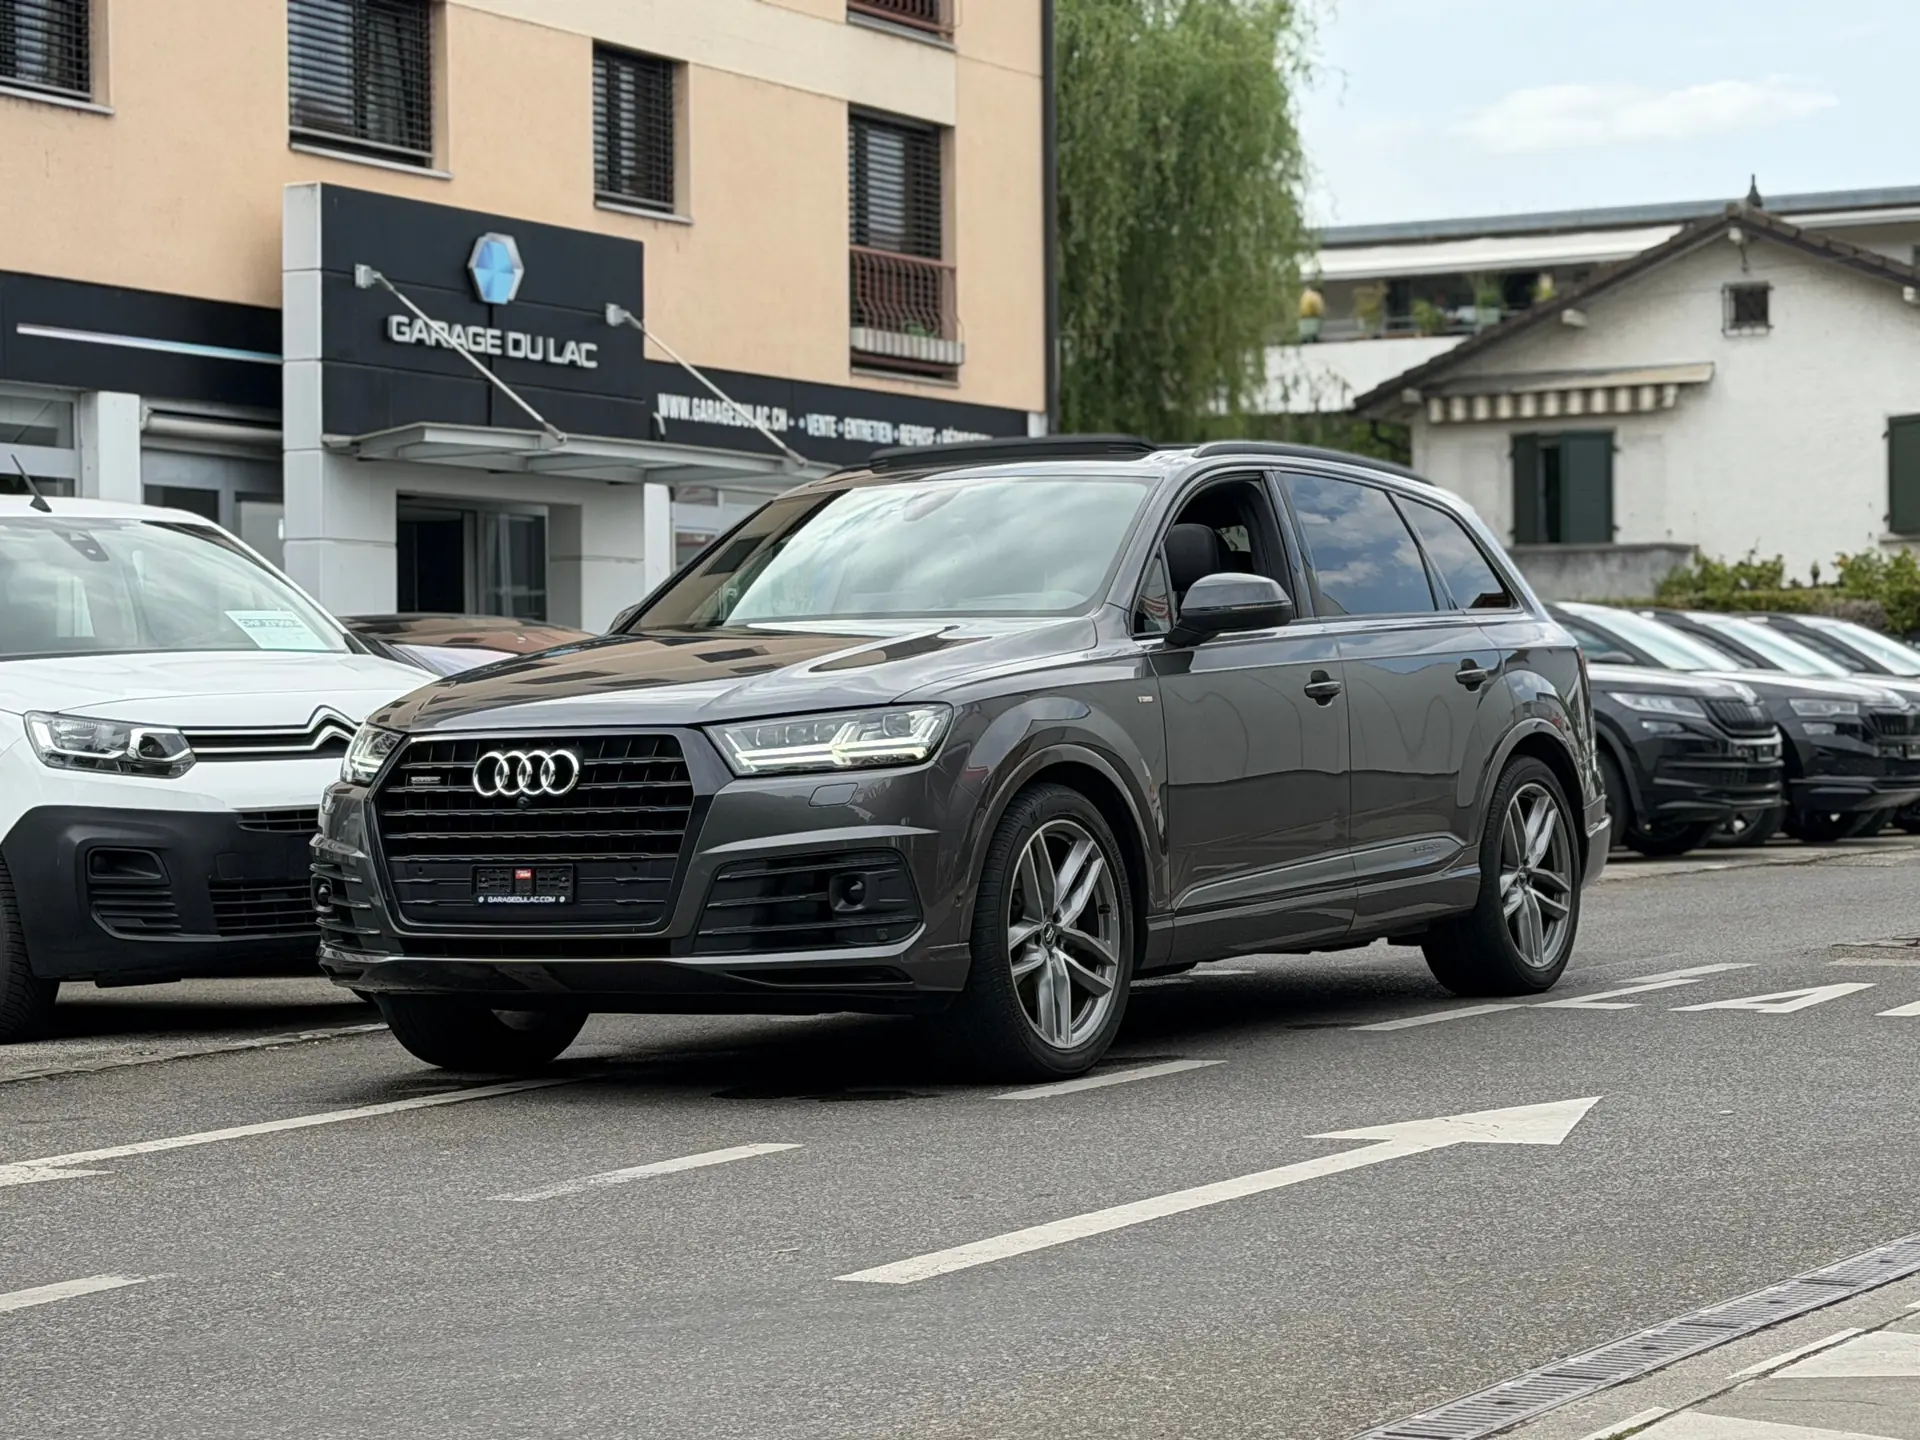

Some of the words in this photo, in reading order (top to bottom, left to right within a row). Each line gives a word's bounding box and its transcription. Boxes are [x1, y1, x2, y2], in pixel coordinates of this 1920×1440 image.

[387, 315, 503, 356] GARAGE
[505, 331, 544, 361] DU
[547, 337, 599, 369] LAC
[806, 413, 838, 438] VENTE
